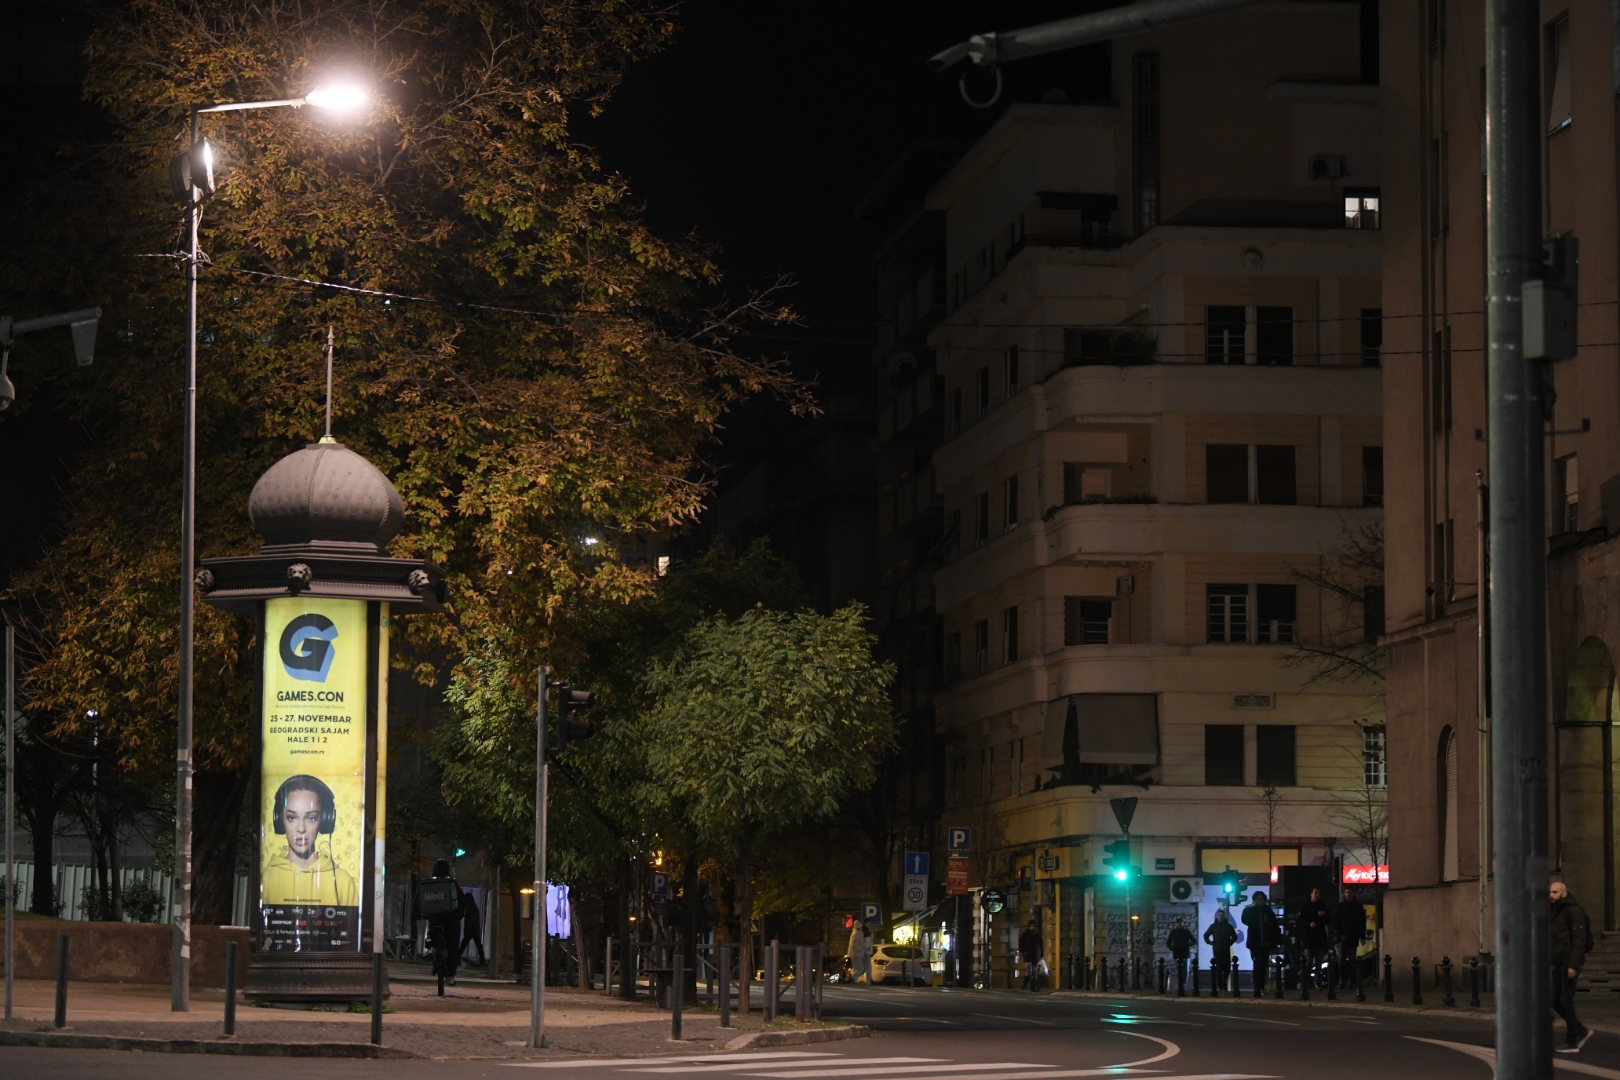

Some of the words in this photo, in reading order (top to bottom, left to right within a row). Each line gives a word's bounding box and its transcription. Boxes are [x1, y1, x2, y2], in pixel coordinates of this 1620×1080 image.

[276, 690, 344, 703] GAMES.CON
[298, 715, 352, 723] NOVEMBAR
[953, 830, 966, 848] P
[654, 874, 665, 892] P
[424, 891, 445, 901] Wolt
[910, 890, 920, 900] 30
[865, 905, 878, 918] P
